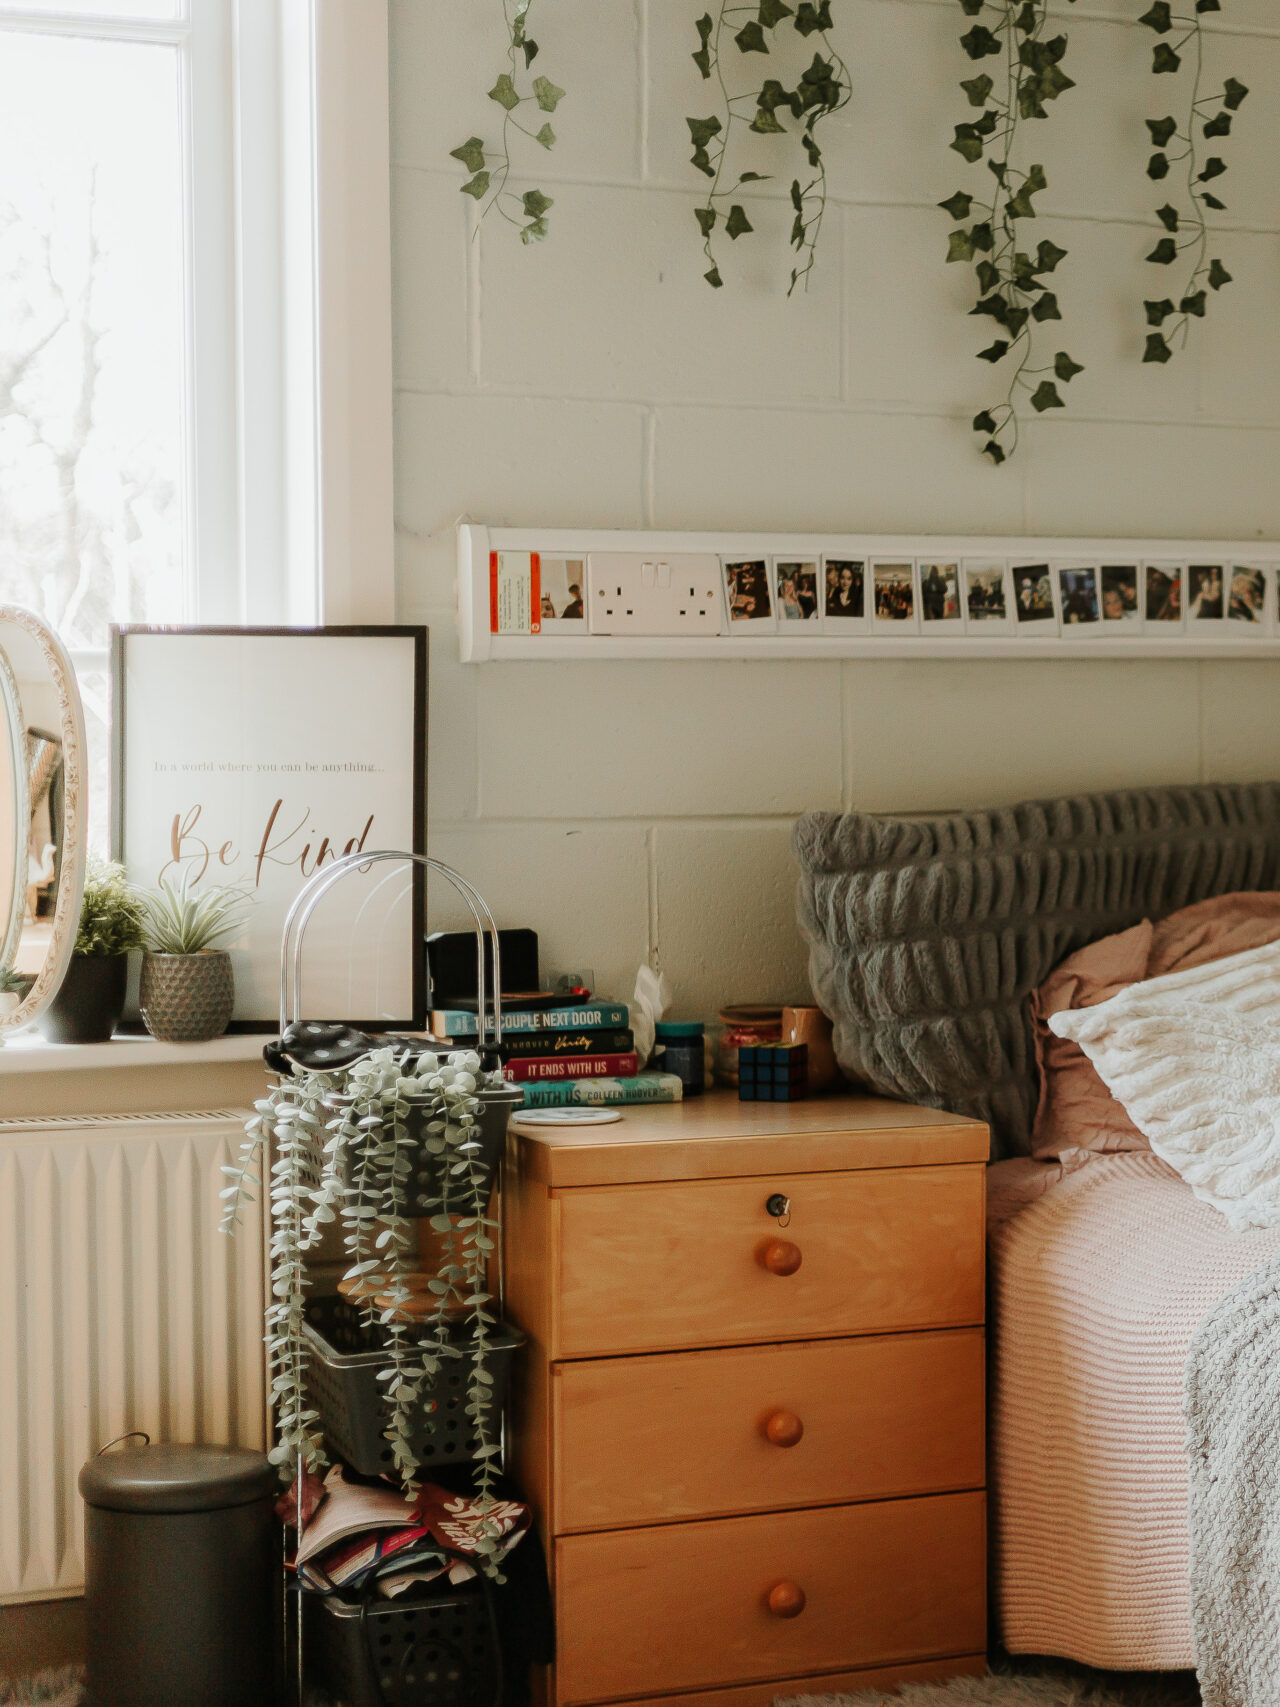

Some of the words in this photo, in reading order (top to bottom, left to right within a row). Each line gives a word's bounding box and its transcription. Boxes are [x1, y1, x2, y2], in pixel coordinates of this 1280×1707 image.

[154, 762, 166, 772] In
[170, 764, 178, 772] a
[181, 762, 214, 772] world
[218, 762, 252, 772] where
[256, 764, 277, 774] you
[280, 764, 301, 772] can
[305, 762, 319, 772] be
[158, 804, 240, 890] Be
[254, 798, 374, 888] Kind
[499, 1014, 540, 1028] COUPLE
[542, 1012, 569, 1026] NEXT
[572, 1010, 602, 1025] DOOR
[554, 1035, 592, 1050] Verity
[528, 1064, 537, 1076] IT
[540, 1063, 565, 1076] ENDS
[568, 1062, 592, 1074] WITH
[594, 1061, 607, 1073] US
[529, 1091, 563, 1105] WITH
[564, 1090, 581, 1104] US
[587, 1090, 623, 1100] COLLEEN
[626, 1088, 658, 1098] HOOVER
